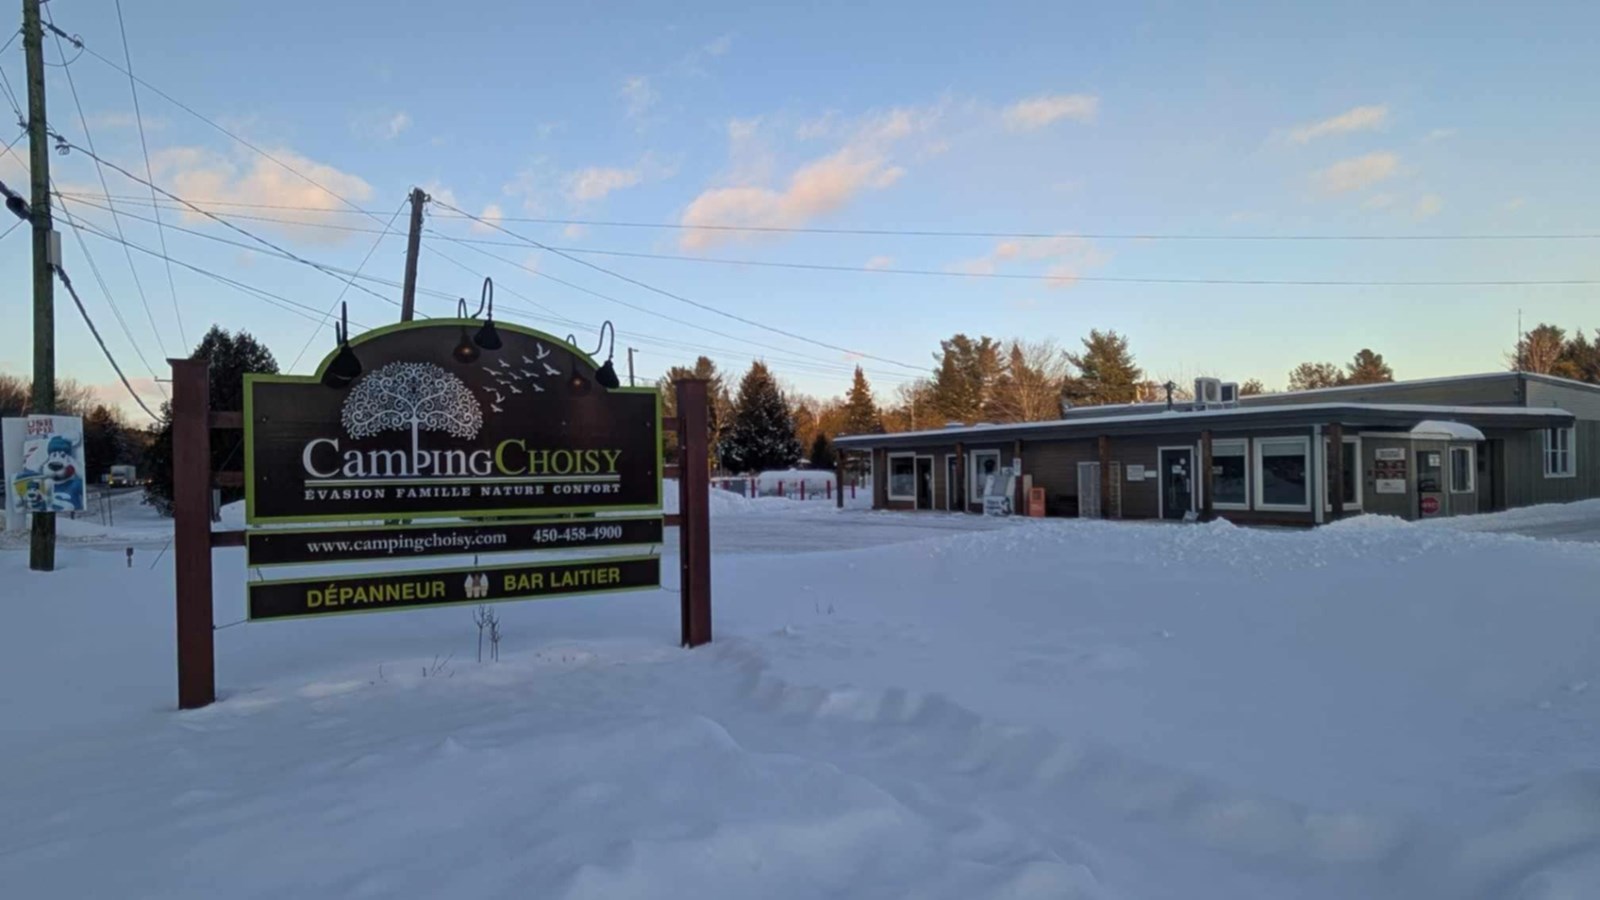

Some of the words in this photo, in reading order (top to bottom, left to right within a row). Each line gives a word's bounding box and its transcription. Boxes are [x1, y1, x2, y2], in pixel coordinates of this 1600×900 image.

[304, 487, 386, 500] ÉVASION
[396, 486, 471, 499] FAMILLE
[480, 485, 545, 497] NATURE
[552, 483, 621, 495] CONFORT
[307, 532, 507, 553] www.campingchoisy.com
[533, 526, 622, 542] 450-458-4900
[307, 580, 446, 608] DÉPANNEUR
[503, 573, 543, 591] BAR
[551, 567, 621, 588] LAITIER
